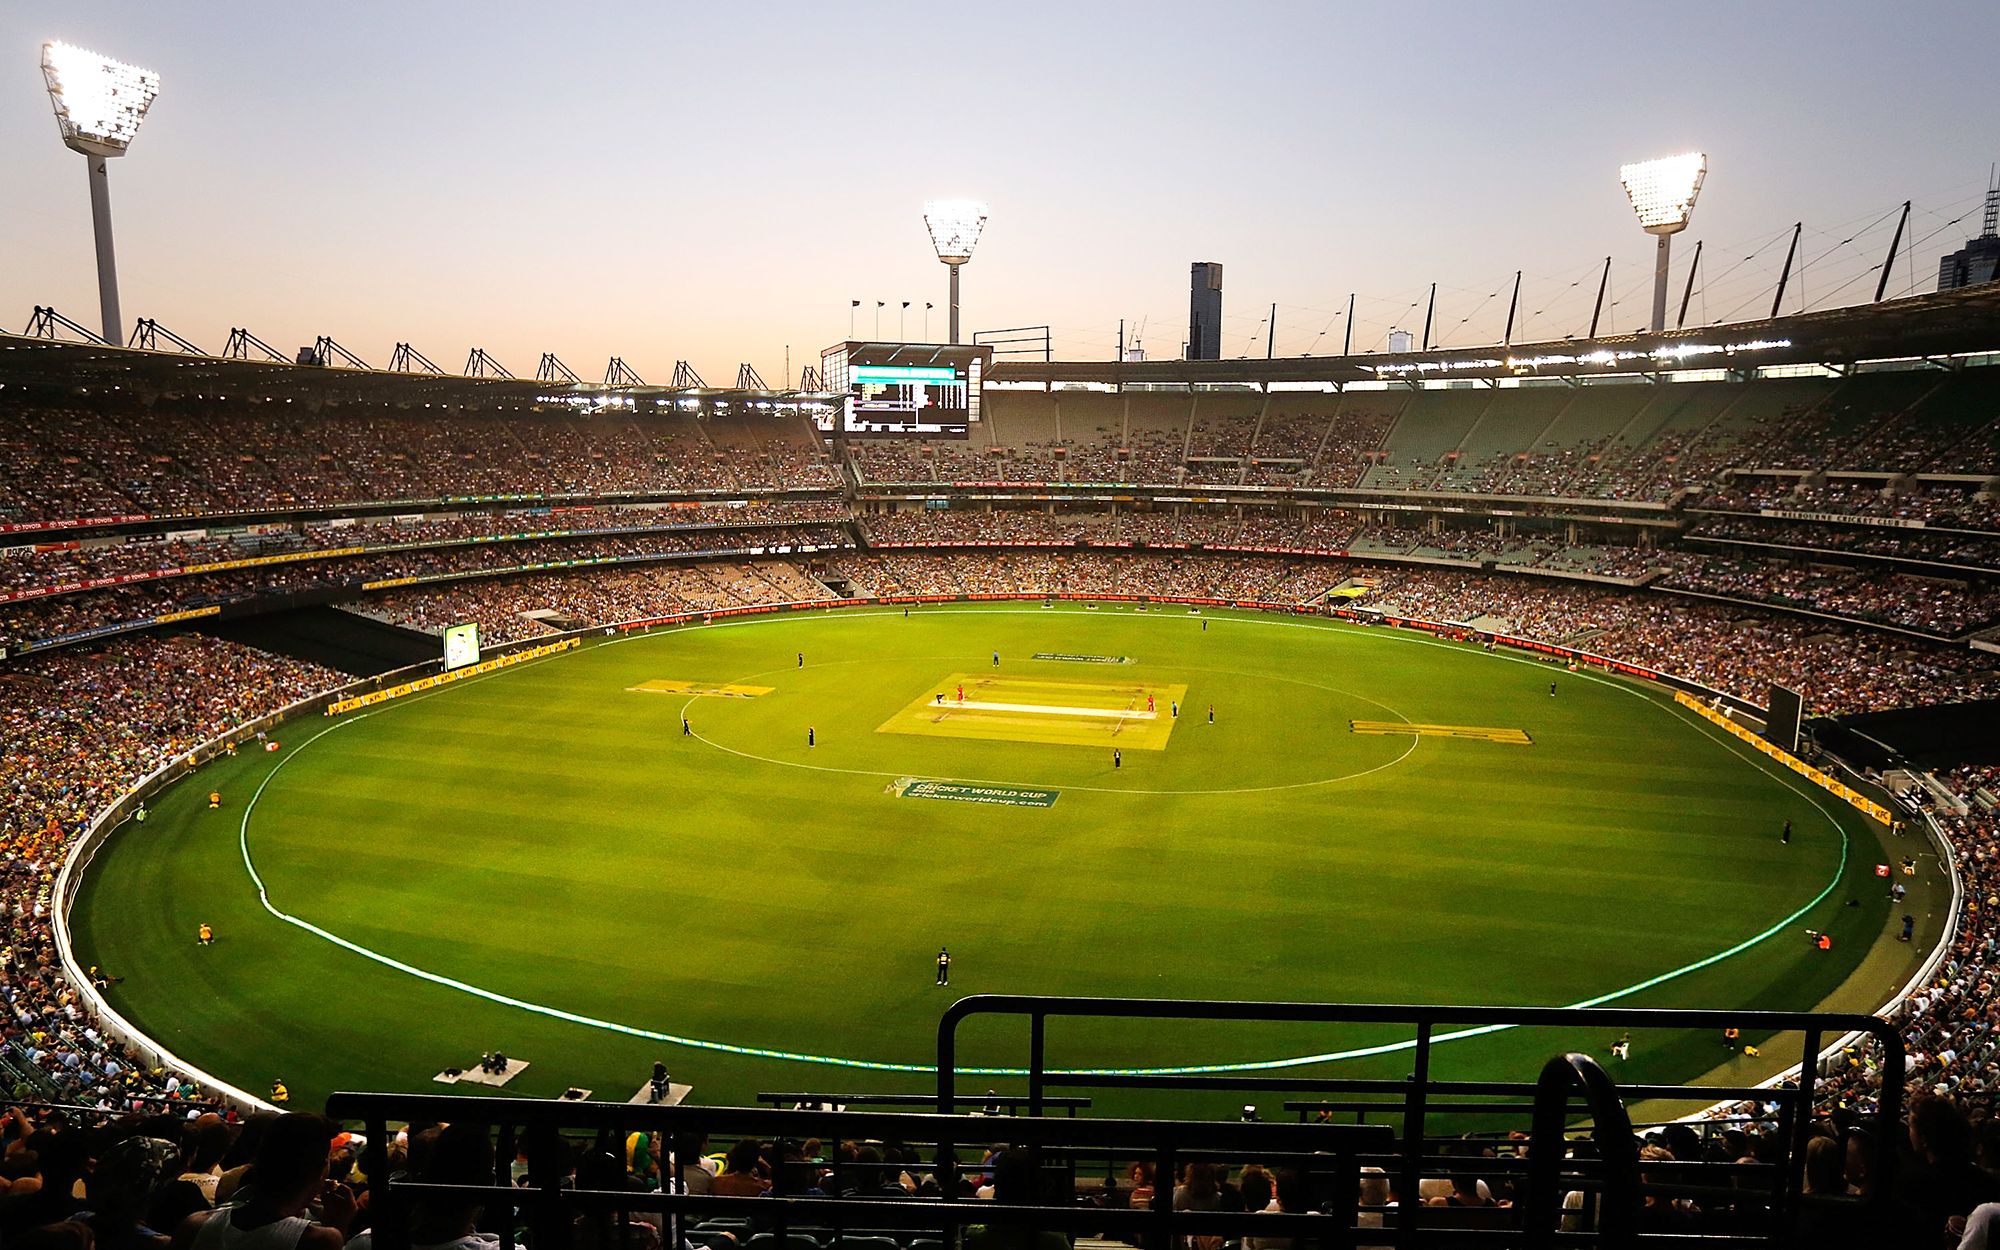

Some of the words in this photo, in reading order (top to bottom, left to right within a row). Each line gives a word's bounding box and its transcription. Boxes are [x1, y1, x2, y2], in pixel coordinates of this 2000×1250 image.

[1658, 239, 1665, 248] 6
[952, 268, 958, 276] 5
[62, 583, 82, 591] TOYOTA
[26, 588, 46, 596] TOYOTA
[370, 694, 380, 702] KFC
[342, 702, 355, 710] KFC
[916, 783, 970, 792] CRICKET
[971, 788, 1018, 796] WORLD
[908, 793, 1048, 806] cricketworldcup.com
[1852, 796, 1863, 805] KFC
[1875, 810, 1888, 820] KFC
